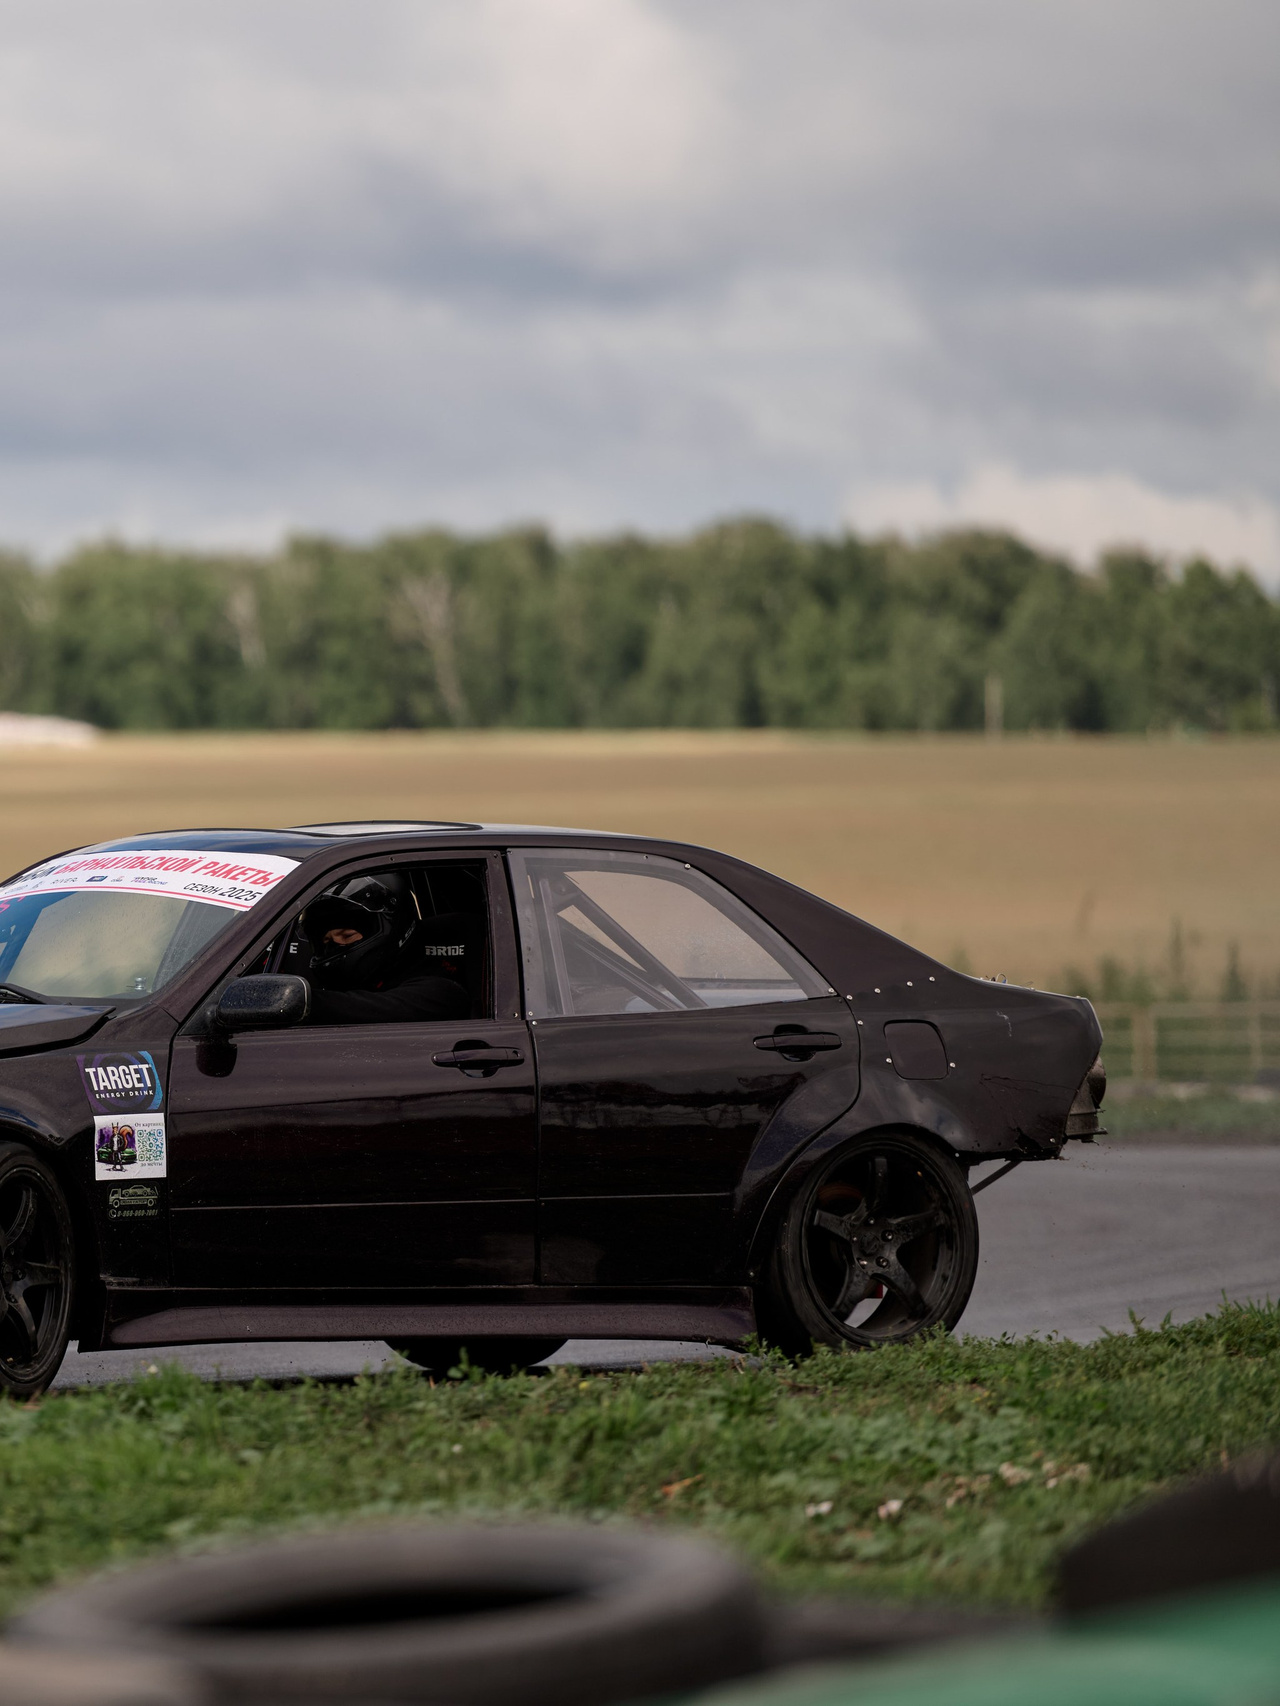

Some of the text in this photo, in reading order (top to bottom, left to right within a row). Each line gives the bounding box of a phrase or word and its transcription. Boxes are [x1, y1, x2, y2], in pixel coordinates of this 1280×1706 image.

[53, 856, 207, 875] БАРНАУЛЬСКОЙ
[191, 860, 286, 887] РАКЕТЫ
[183, 883, 263, 902] СЕЗОН 2025
[425, 944, 465, 956] BRIDE
[85, 1064, 152, 1091] TARGET
[95, 1089, 154, 1099] ENERGY DRINK
